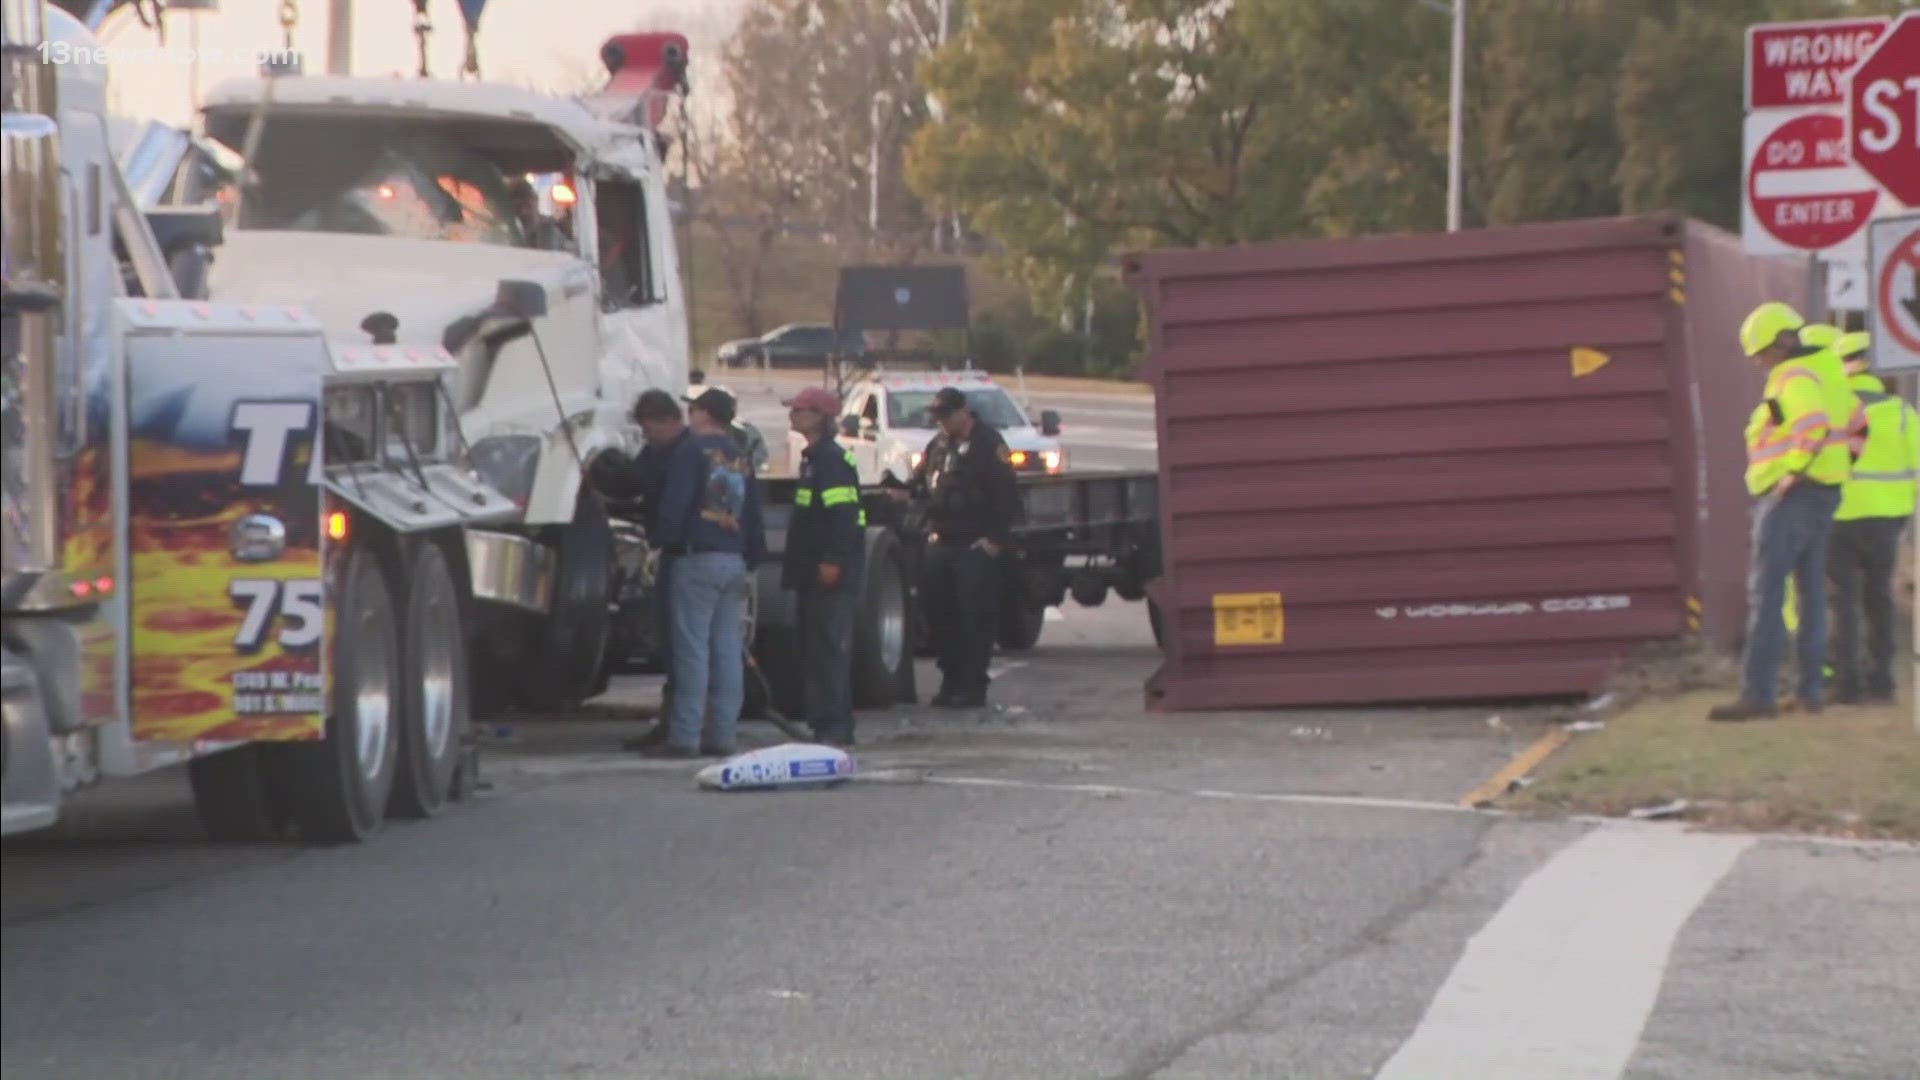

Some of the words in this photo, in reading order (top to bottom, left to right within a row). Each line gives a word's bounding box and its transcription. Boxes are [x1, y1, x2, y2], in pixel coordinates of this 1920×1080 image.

[1764, 32, 1875, 67] WRONG
[1785, 68, 1845, 98] WAY
[1767, 140, 1806, 165] DO
[1774, 198, 1855, 226] ENTER
